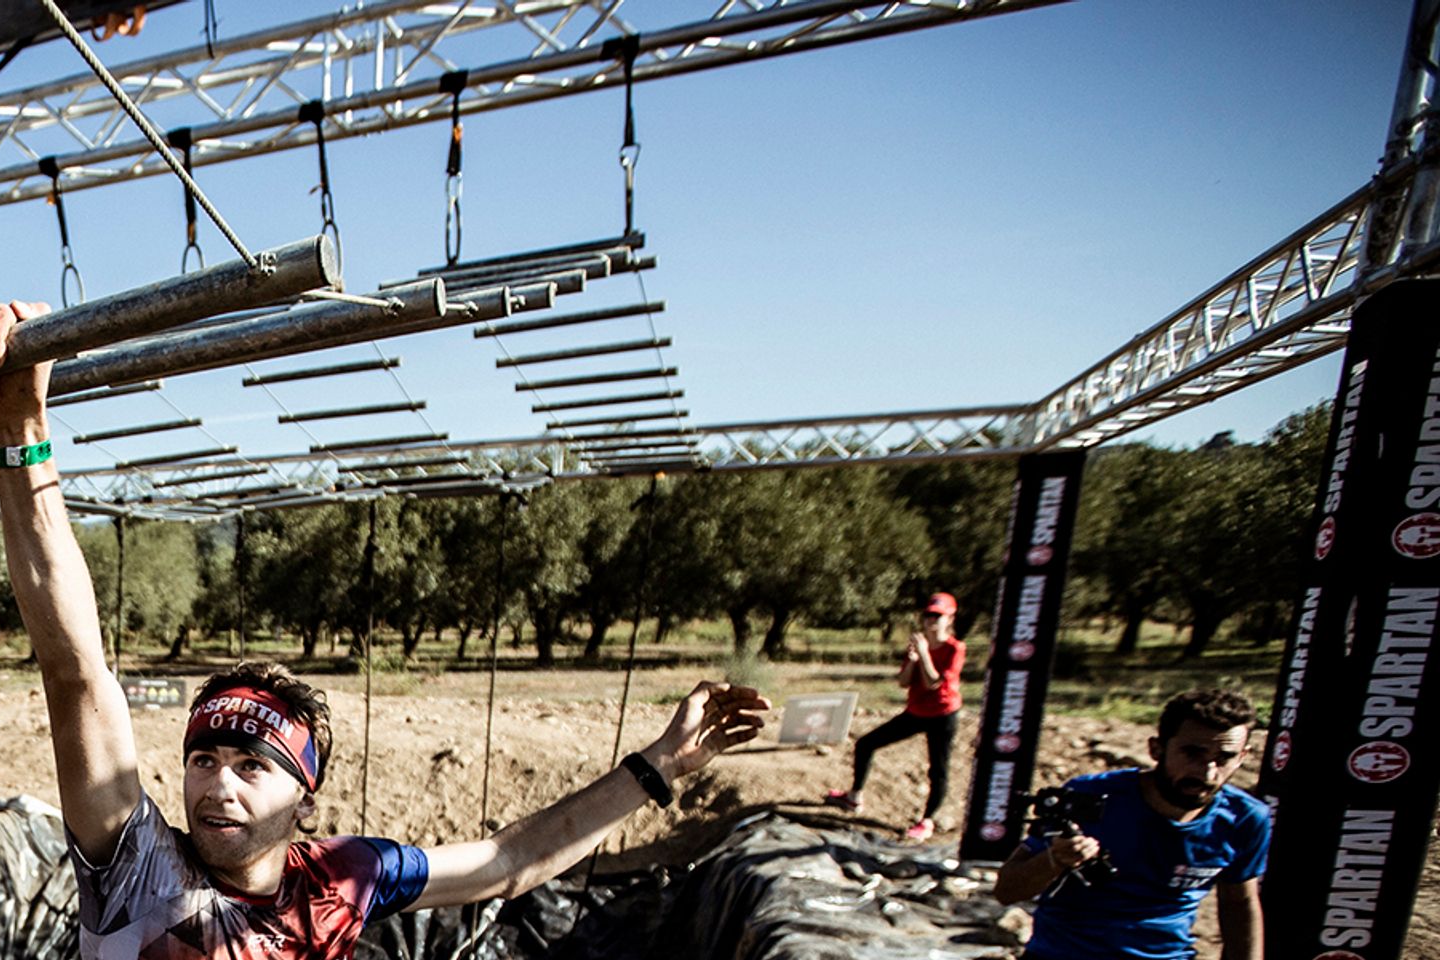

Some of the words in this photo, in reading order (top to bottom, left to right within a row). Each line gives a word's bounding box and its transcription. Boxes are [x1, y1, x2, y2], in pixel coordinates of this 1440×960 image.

[1323, 359, 1369, 514] SPARTAN
[1030, 476, 1068, 546] SPARTAN
[205, 696, 294, 739] SPARTAN
[1279, 586, 1322, 728] SPARTAN
[1360, 586, 1439, 738] SPARTAN
[1320, 808, 1395, 948] SPARTAN
